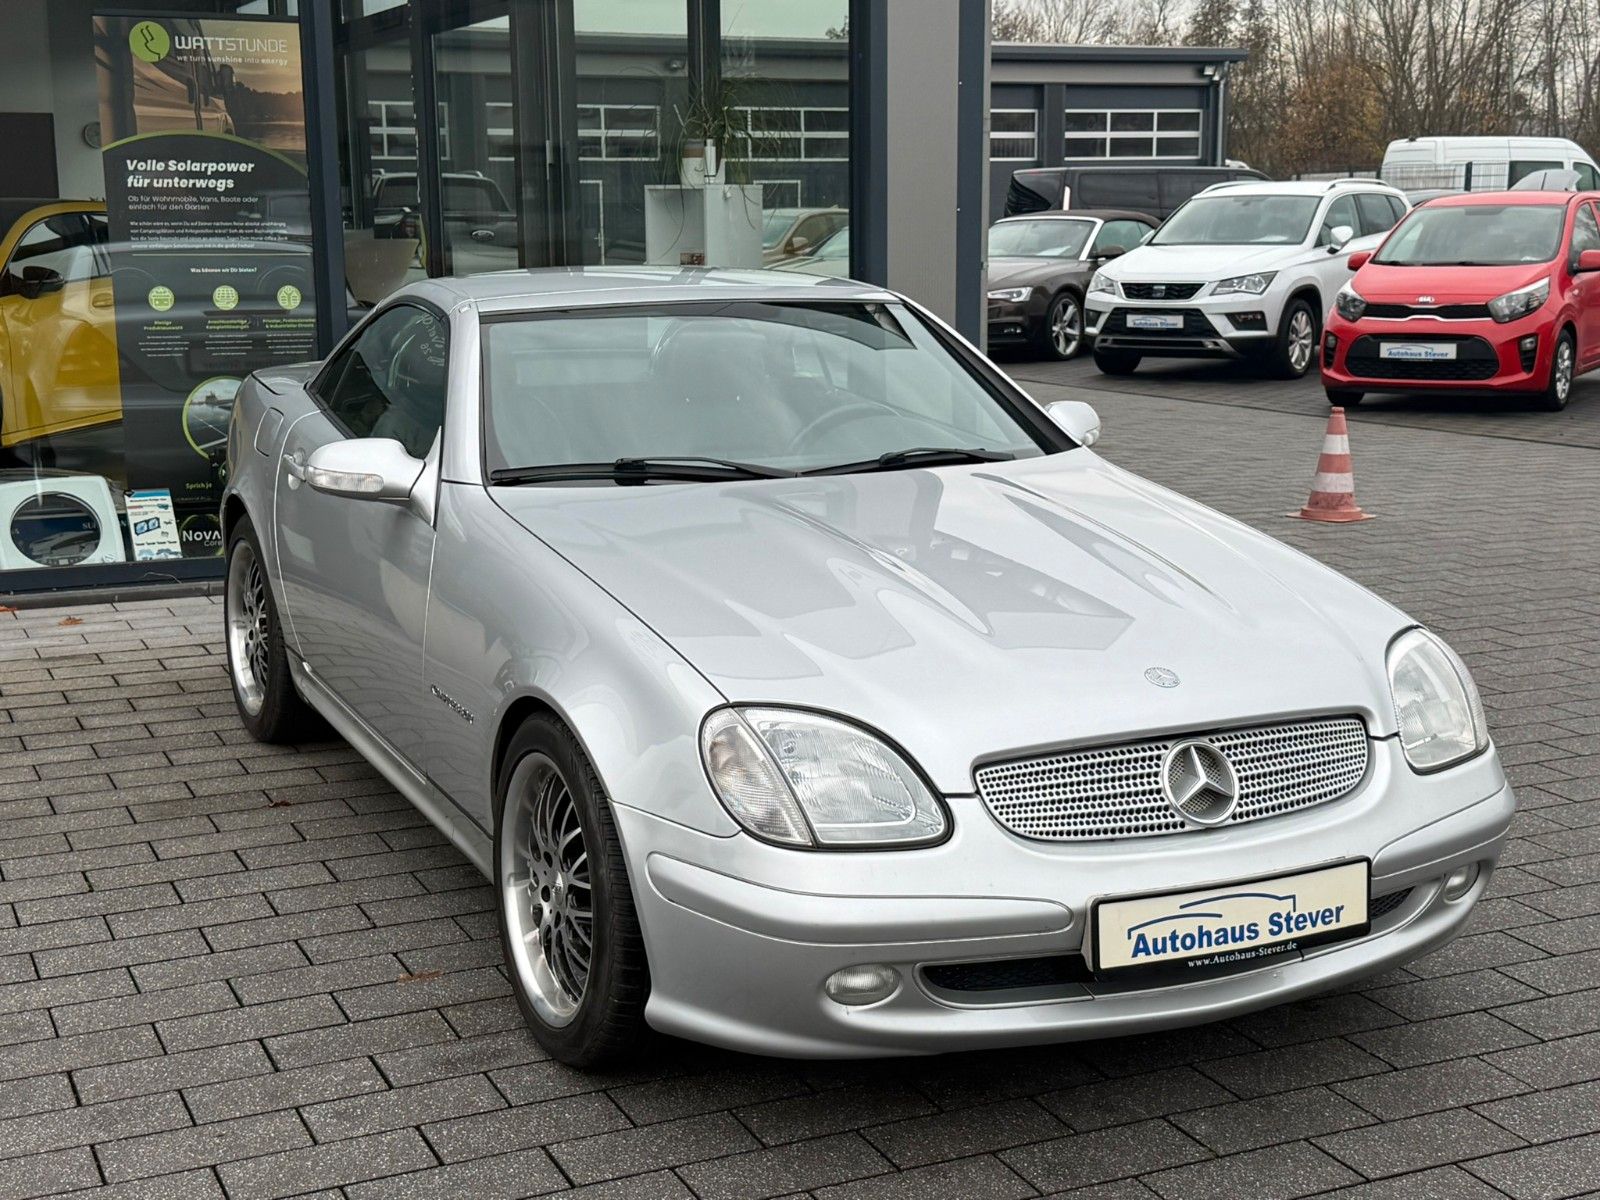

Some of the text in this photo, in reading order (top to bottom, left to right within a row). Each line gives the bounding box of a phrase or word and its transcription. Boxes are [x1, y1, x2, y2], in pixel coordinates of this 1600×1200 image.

[174, 35, 288, 53] WATTSTUNDE
[208, 56, 242, 64] sunshine
[244, 56, 260, 64] into
[261, 58, 289, 66] energy
[126, 159, 255, 175] Volle Solarpower
[127, 175, 235, 192] für unterwegs
[127, 195, 139, 203] Ob
[140, 195, 151, 203] für
[1424, 350, 1449, 358] Stever
[1131, 904, 1345, 958] Autohaus Stever
[1187, 941, 1298, 968] www.Autohaus-Stever.de
